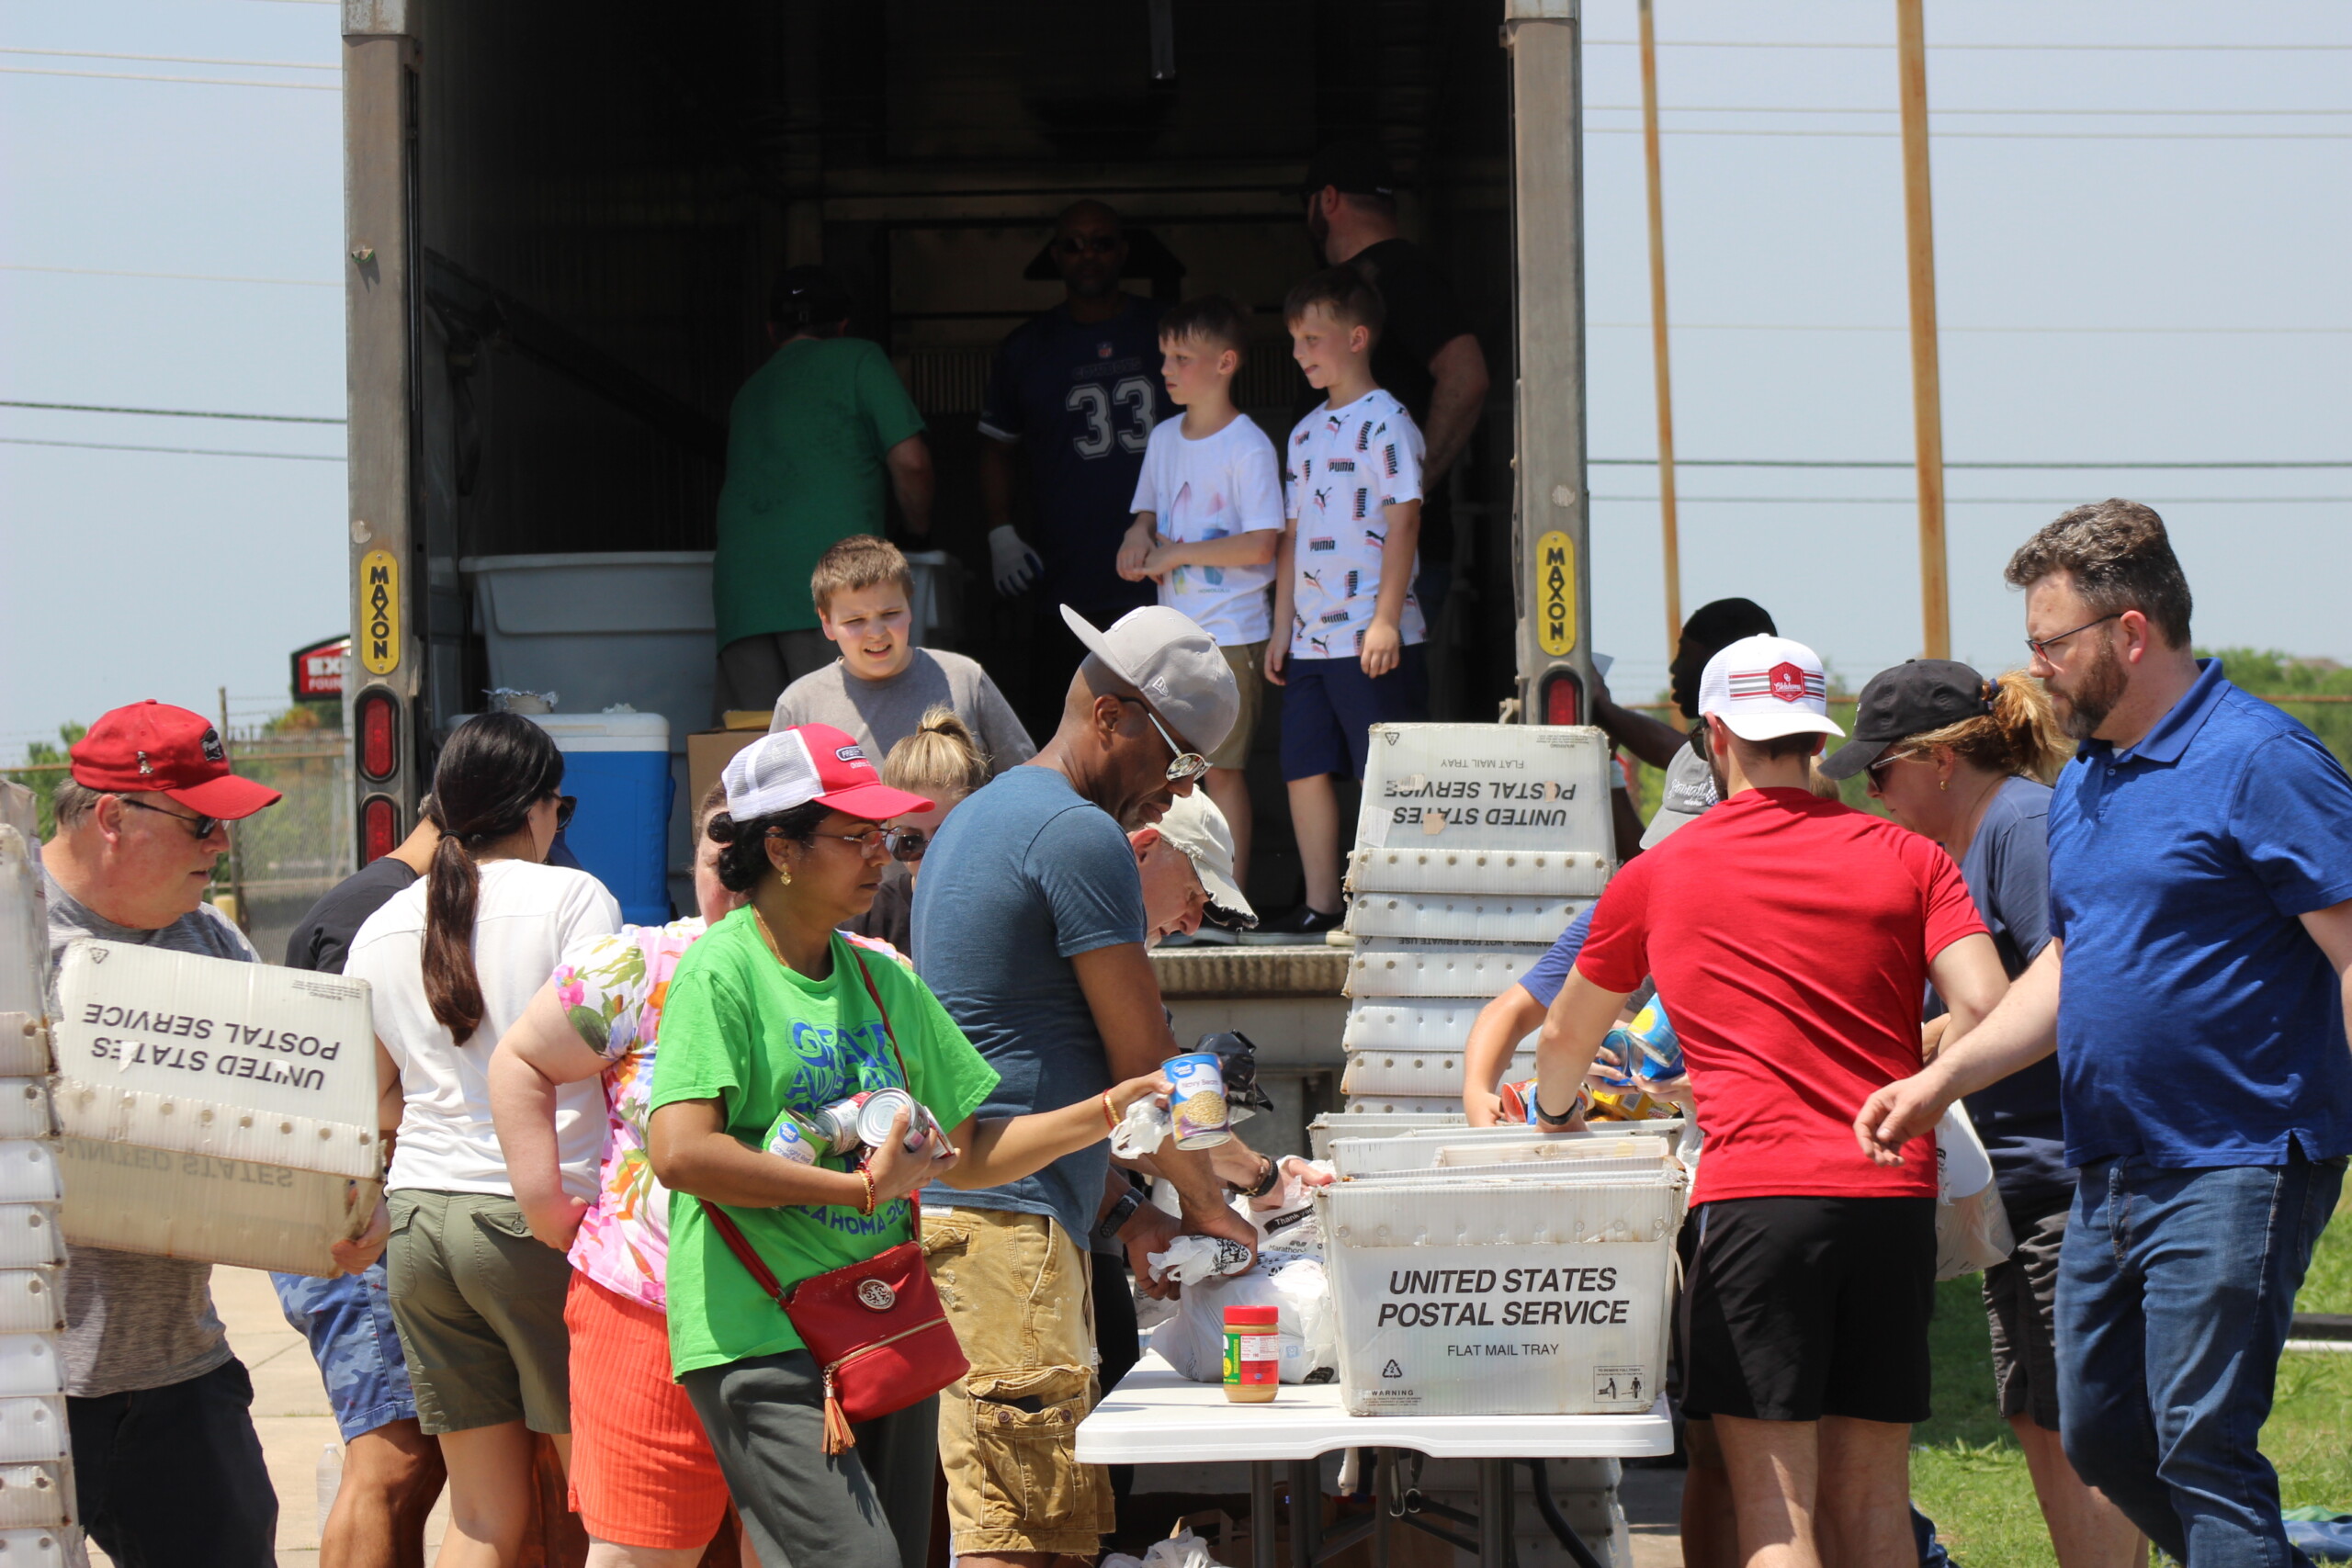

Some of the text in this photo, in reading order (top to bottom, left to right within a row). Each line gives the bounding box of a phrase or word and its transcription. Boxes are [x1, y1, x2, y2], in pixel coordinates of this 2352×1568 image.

[1066, 376, 1155, 460] 33
[1329, 462, 1355, 472] PUMA
[1385, 444, 1397, 475] PUMA
[1356, 488, 1367, 518] PUMA
[1310, 540, 1335, 551] PUMA
[1546, 547, 1566, 640] MAXON
[369, 566, 390, 660] MAXON
[1441, 759, 1524, 769] FLAT MAIL TRAY
[1393, 807, 1566, 827] UNITED STAES
[1397, 937, 1419, 945] USE
[1423, 938, 1461, 946] PRIVATE
[82, 1003, 341, 1061] POSTAL SERVICE
[786, 1017, 891, 1072] GRAT
[216, 1055, 325, 1091] UNITED
[786, 1145, 801, 1156] Light
[1275, 1213, 1300, 1225] Thank
[1389, 1267, 1617, 1295] UNITED STATES
[1377, 1300, 1630, 1327] POSTAL SERVICE
[1447, 1344, 1559, 1357] FLAT MAIL TRAY
